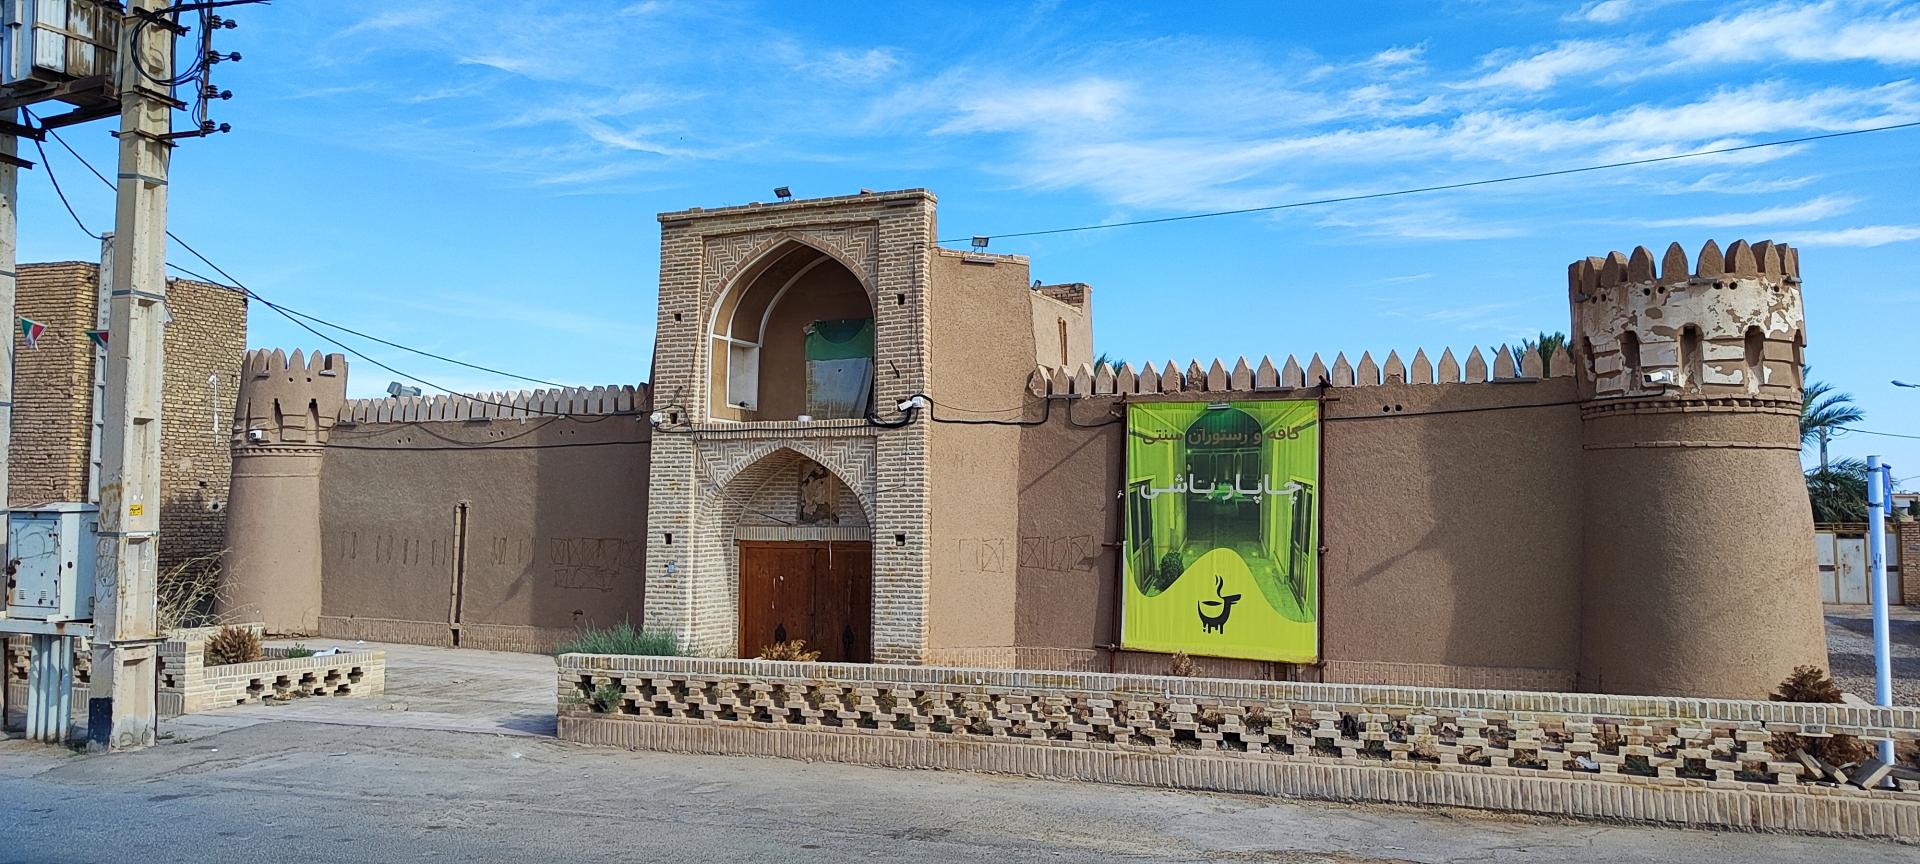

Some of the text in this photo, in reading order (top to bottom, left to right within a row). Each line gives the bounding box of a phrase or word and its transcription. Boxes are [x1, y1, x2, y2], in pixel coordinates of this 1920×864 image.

[1142, 425, 1301, 445] کافه و رستوران سنتی
[1140, 473, 1303, 504] چاپار باشی
